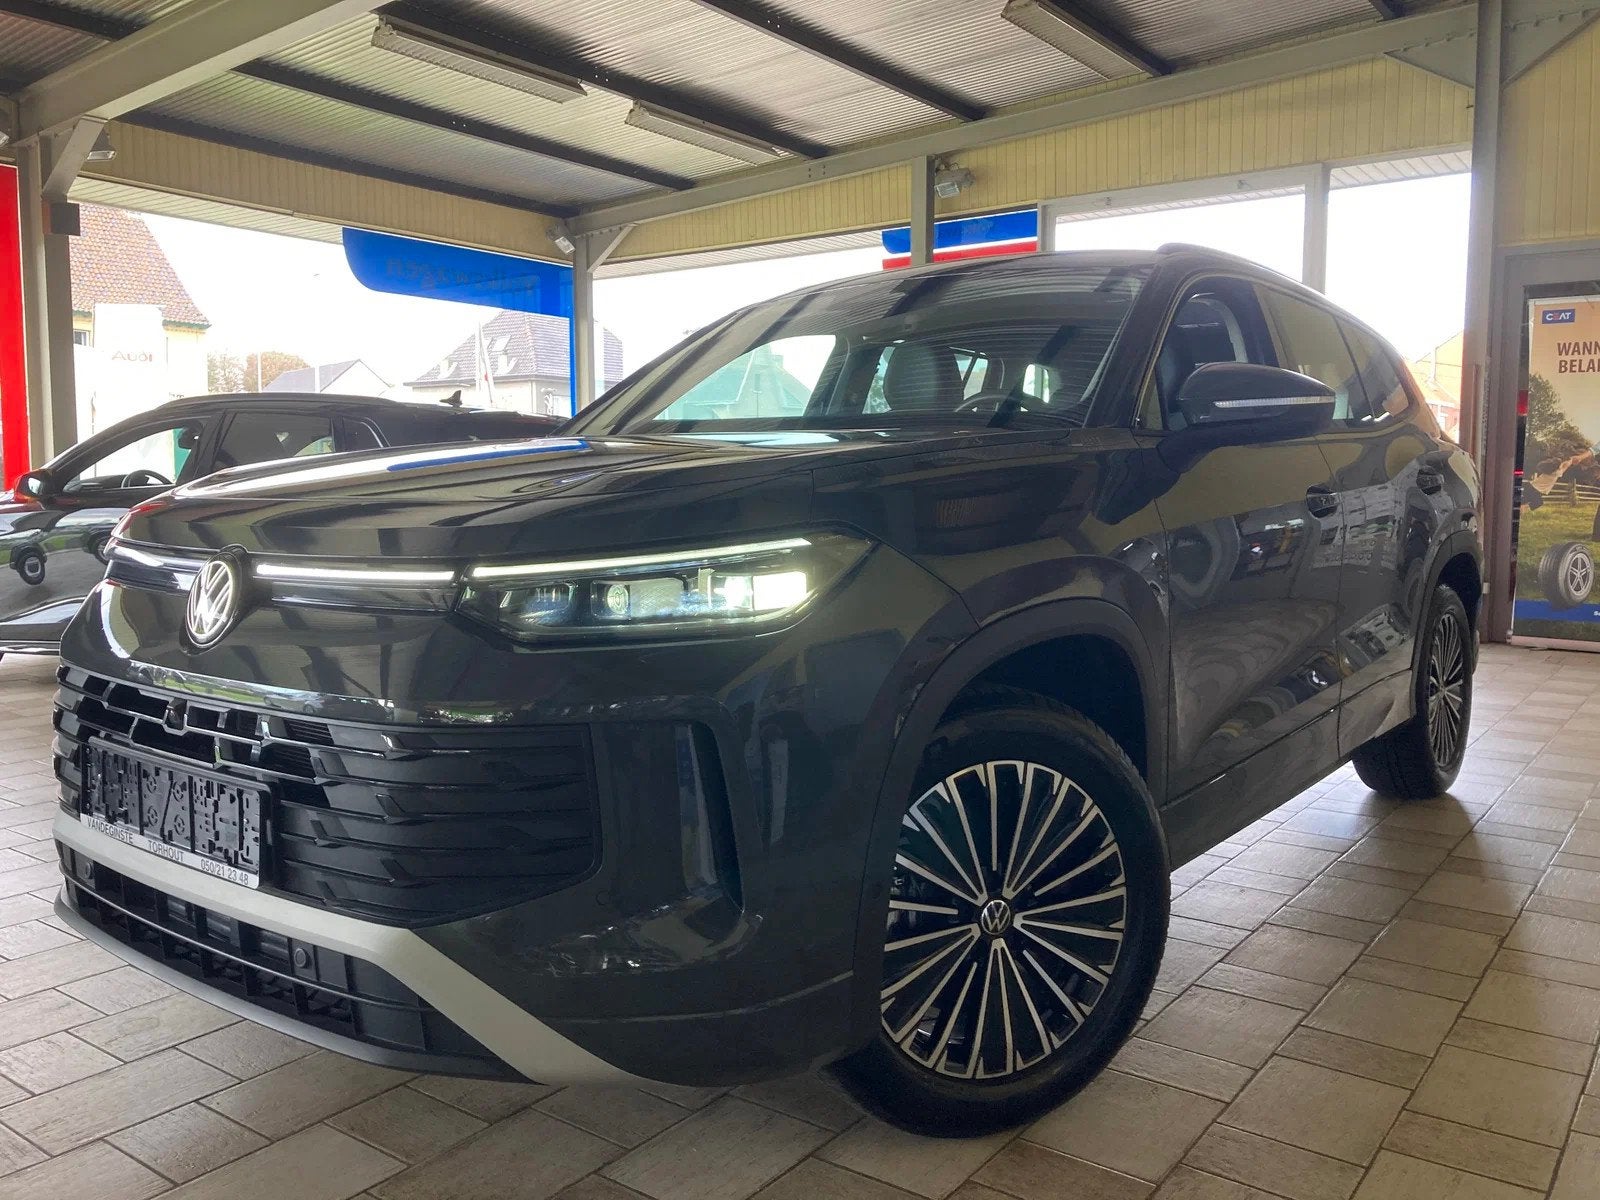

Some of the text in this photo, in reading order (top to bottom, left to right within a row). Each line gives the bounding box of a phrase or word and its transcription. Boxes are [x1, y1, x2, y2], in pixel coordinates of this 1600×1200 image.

[87, 816, 249, 886] VANDEGINSTE TORHOUT 050/21 23 48
